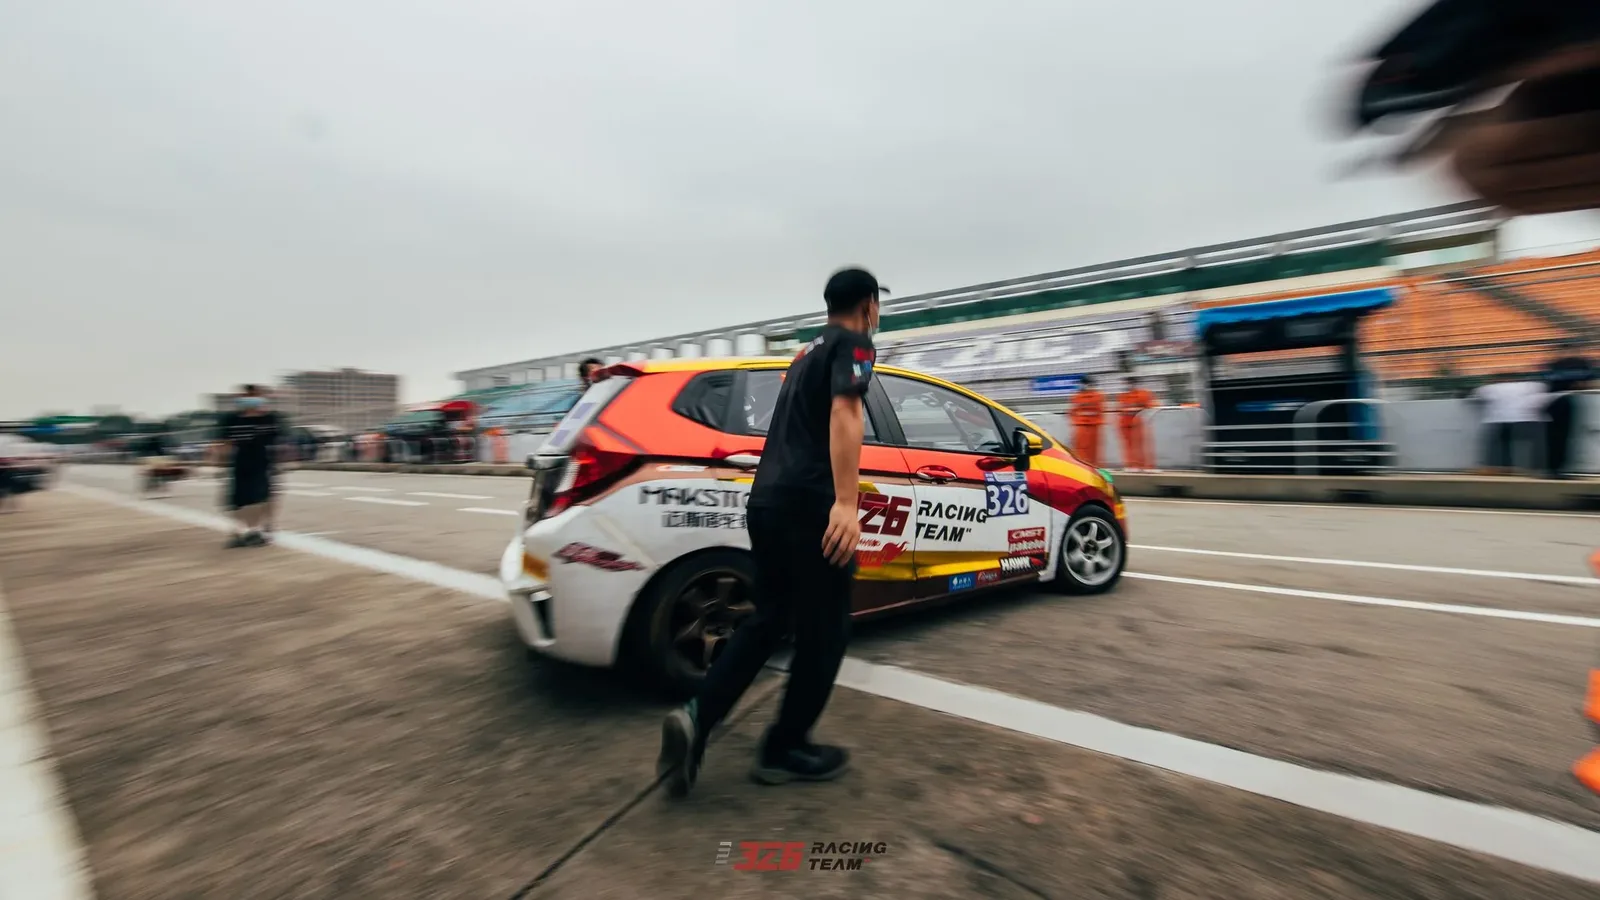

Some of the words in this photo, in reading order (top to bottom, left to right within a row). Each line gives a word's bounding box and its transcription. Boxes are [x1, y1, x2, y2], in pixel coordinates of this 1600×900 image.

[857, 491, 912, 536] 26
[917, 501, 987, 523] RACING
[987, 484, 1028, 516] 326
[1000, 556, 1030, 571] HAWK
